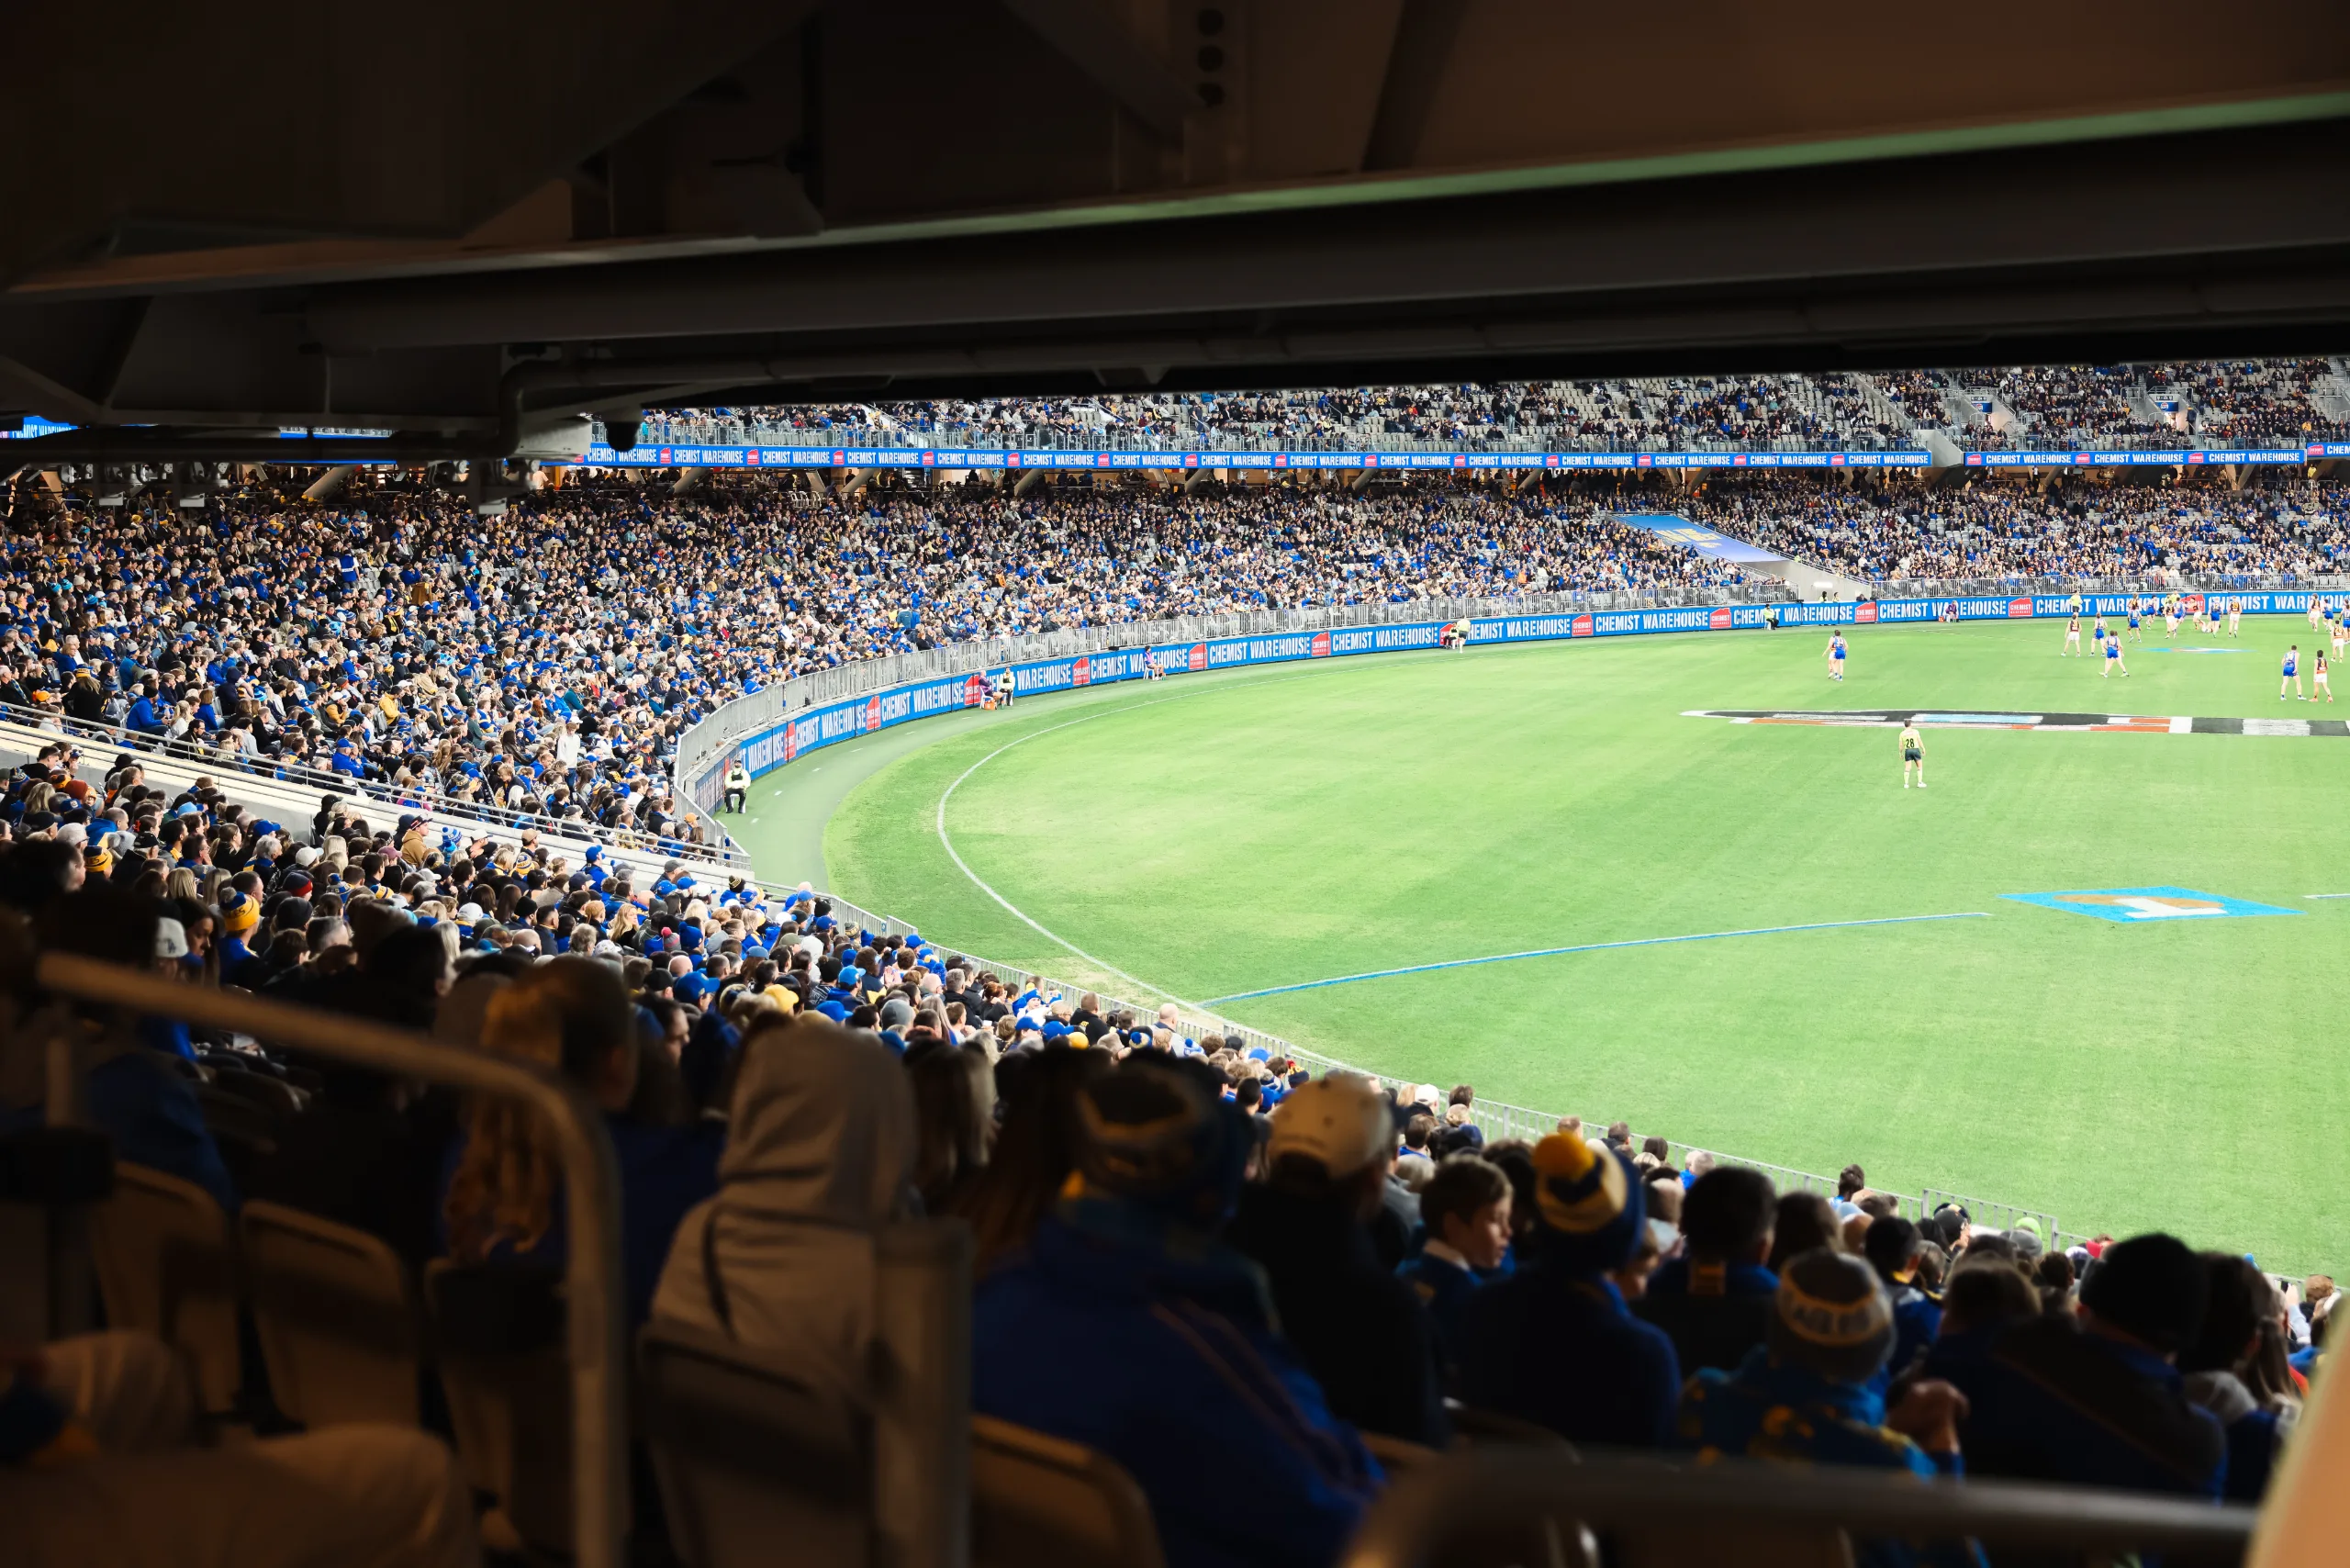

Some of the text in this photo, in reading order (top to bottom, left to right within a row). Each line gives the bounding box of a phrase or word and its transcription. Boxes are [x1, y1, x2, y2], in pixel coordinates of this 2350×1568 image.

[618, 449, 656, 463] WAREHOUSE
[674, 449, 700, 464] CHEMIST
[701, 450, 744, 464] WAREHOUSE
[762, 451, 791, 464] CHEMIST
[792, 451, 830, 464] WAREHOUSE
[847, 452, 877, 465] CHEMIST
[878, 452, 919, 465] WAREHOUSE
[937, 453, 966, 465] CHEMIST
[967, 453, 1004, 465] WAREHOUSE
[1024, 454, 1053, 465] CHEMIST
[1055, 454, 1094, 465] WAREHOUSE
[1113, 454, 1141, 465] CHEMIST
[1141, 454, 1181, 465] WAREHOUSE
[1201, 454, 1231, 466] CHEMIST
[1232, 455, 1271, 465] WAREHOUSE
[1290, 455, 1318, 466] CHEMIST
[1319, 455, 1361, 466] WAREHOUSE
[1380, 455, 1410, 465] CHEMIST
[1411, 455, 1450, 465] WAREHOUSE
[1469, 455, 1499, 465] CHEMIST
[1501, 455, 1542, 465] WAREHOUSE
[1561, 455, 1592, 465] CHEMIST
[1593, 455, 1633, 465] WAREHOUSE
[1655, 455, 1686, 465] CHEMIST
[1687, 455, 1730, 465] WAREHOUSE
[1750, 455, 1780, 465] CHEMIST
[1782, 455, 1827, 465] WAREHOUSE
[1848, 454, 1881, 465] CHEMIST
[1883, 454, 1929, 465] WAREHOUSE
[1986, 454, 2021, 464] CHEMIST
[2023, 454, 2071, 464] WAREHOUSE
[2094, 454, 2130, 464] CHEMIST
[2132, 454, 2184, 463] WAREHOUSE
[2209, 453, 2246, 463] CHEMIST
[2248, 453, 2300, 462] WAREHOUSE
[1879, 599, 2007, 618] CHEMIST WAEHOUSE
[1733, 605, 1852, 625] CHEMT WAREHOUSE
[1595, 611, 1708, 633] CHEMIST WAREHOUSE
[1468, 619, 1571, 640] HEMIST WAREHOUSE
[1333, 627, 1438, 652] CHEMIST WAREHOUSE
[1210, 637, 1311, 664] CHEMIST WAREHOUSE
[1091, 648, 1187, 679] CHEMIST WAEHOUSE
[1017, 662, 1071, 691] WAREHOUSE
[881, 692, 911, 722] CHEMIST
[913, 681, 964, 713] WAREHOUSE
[795, 705, 867, 750] CHEMIST WAREHOUSE
[1905, 738, 1915, 749] 28
[748, 732, 784, 773] WAREHOUSE
